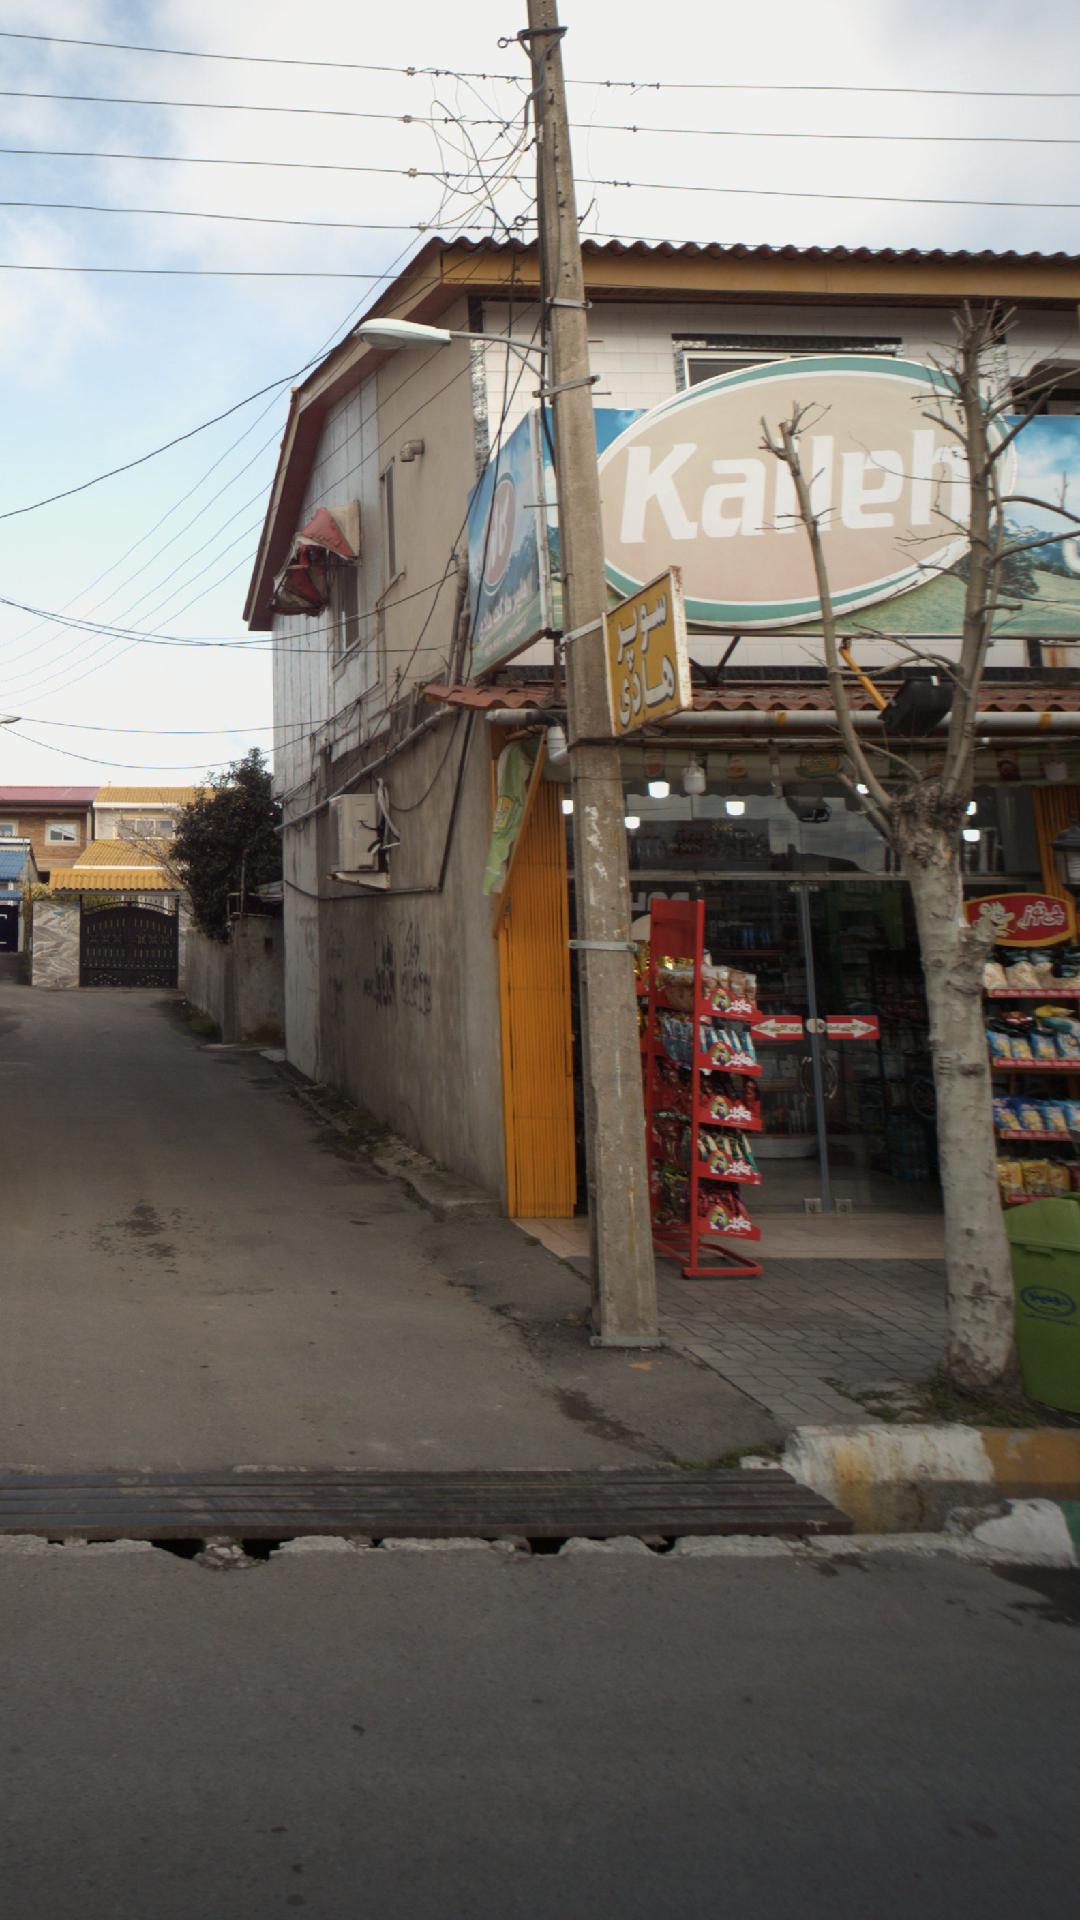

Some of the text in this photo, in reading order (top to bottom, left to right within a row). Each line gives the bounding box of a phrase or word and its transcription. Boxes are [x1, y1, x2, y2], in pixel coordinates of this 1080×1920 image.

[620, 429, 971, 544] Kalleh
[617, 593, 668, 673] سوپر
[618, 655, 675, 726] هادی
